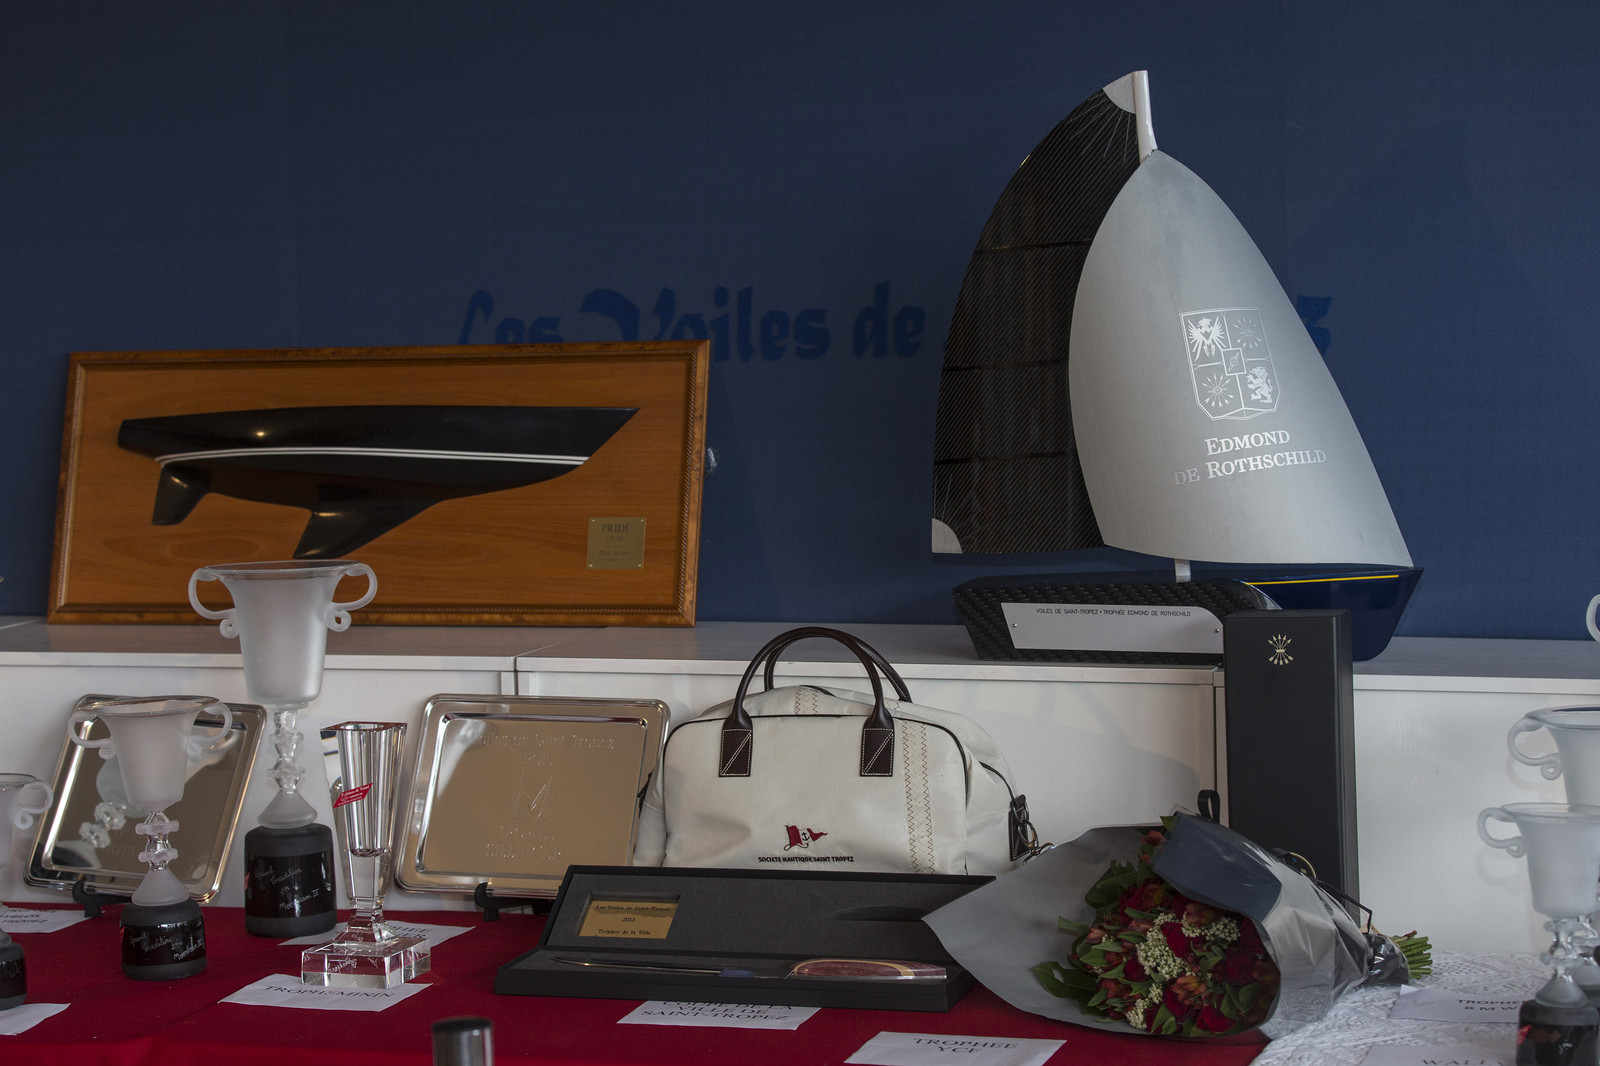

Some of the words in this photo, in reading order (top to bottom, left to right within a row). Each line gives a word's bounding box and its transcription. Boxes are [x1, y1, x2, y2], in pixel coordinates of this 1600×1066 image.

[580, 285, 832, 363] Voiles
[852, 280, 928, 358] de
[1205, 430, 1290, 455] EDMOND
[1173, 468, 1200, 486] DE
[1205, 450, 1326, 479] ROTHSCHILD
[601, 524, 631, 533] PRIDE
[640, 1010, 789, 1020] SAINT-TROPEZ
[914, 1038, 1018, 1049] TROPHEE
